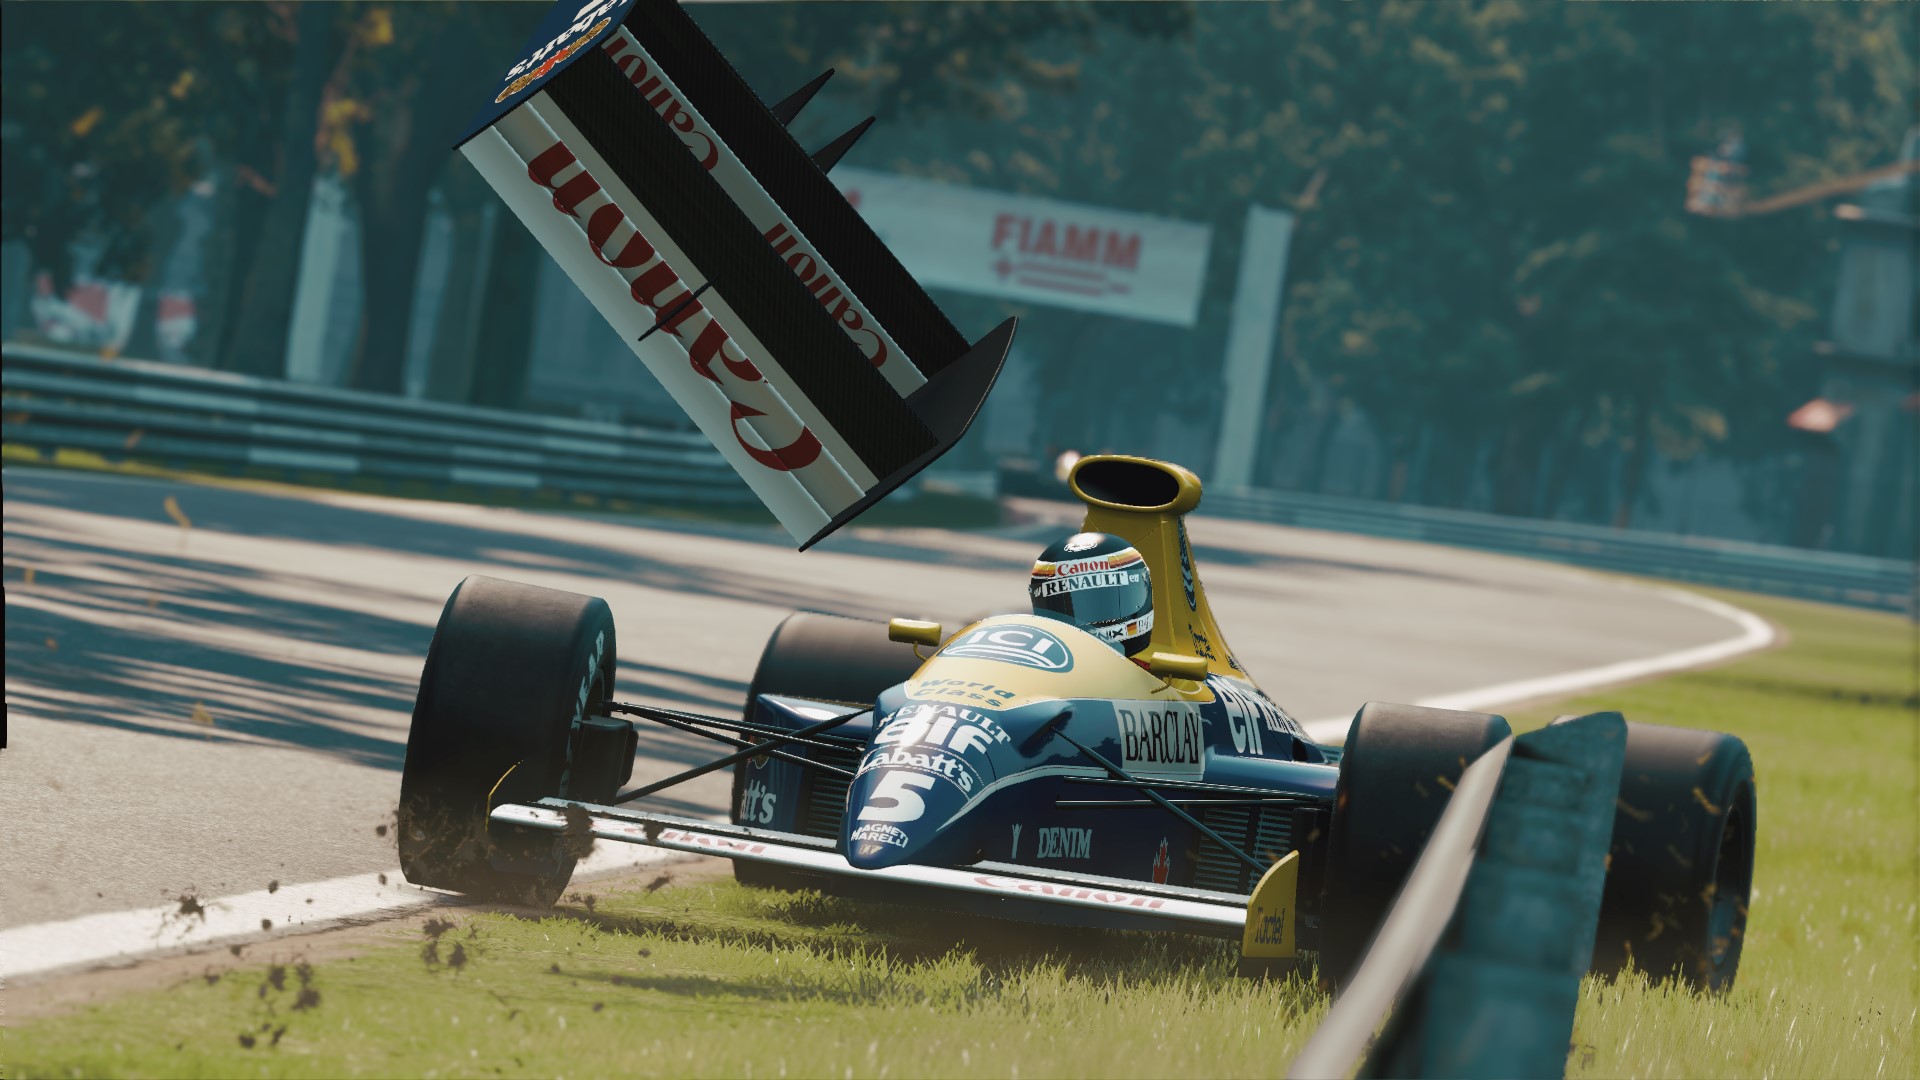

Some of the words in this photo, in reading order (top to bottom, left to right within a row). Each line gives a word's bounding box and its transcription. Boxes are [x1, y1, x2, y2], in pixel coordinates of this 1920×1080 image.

[991, 213, 1143, 270] FIAMM
[528, 141, 822, 471] Canon
[1045, 572, 1125, 597] RENAULT
[1057, 560, 1109, 576] Canon
[966, 629, 1055, 655] ICI
[913, 687, 1003, 707] Class
[921, 678, 1016, 699] World
[876, 703, 1012, 745] RENAULT
[1118, 709, 1200, 764] BARCLAY
[856, 746, 974, 793] Labatt's
[857, 770, 936, 823] 5
[1037, 827, 1093, 859] DENIM
[973, 875, 1166, 909] Canon
